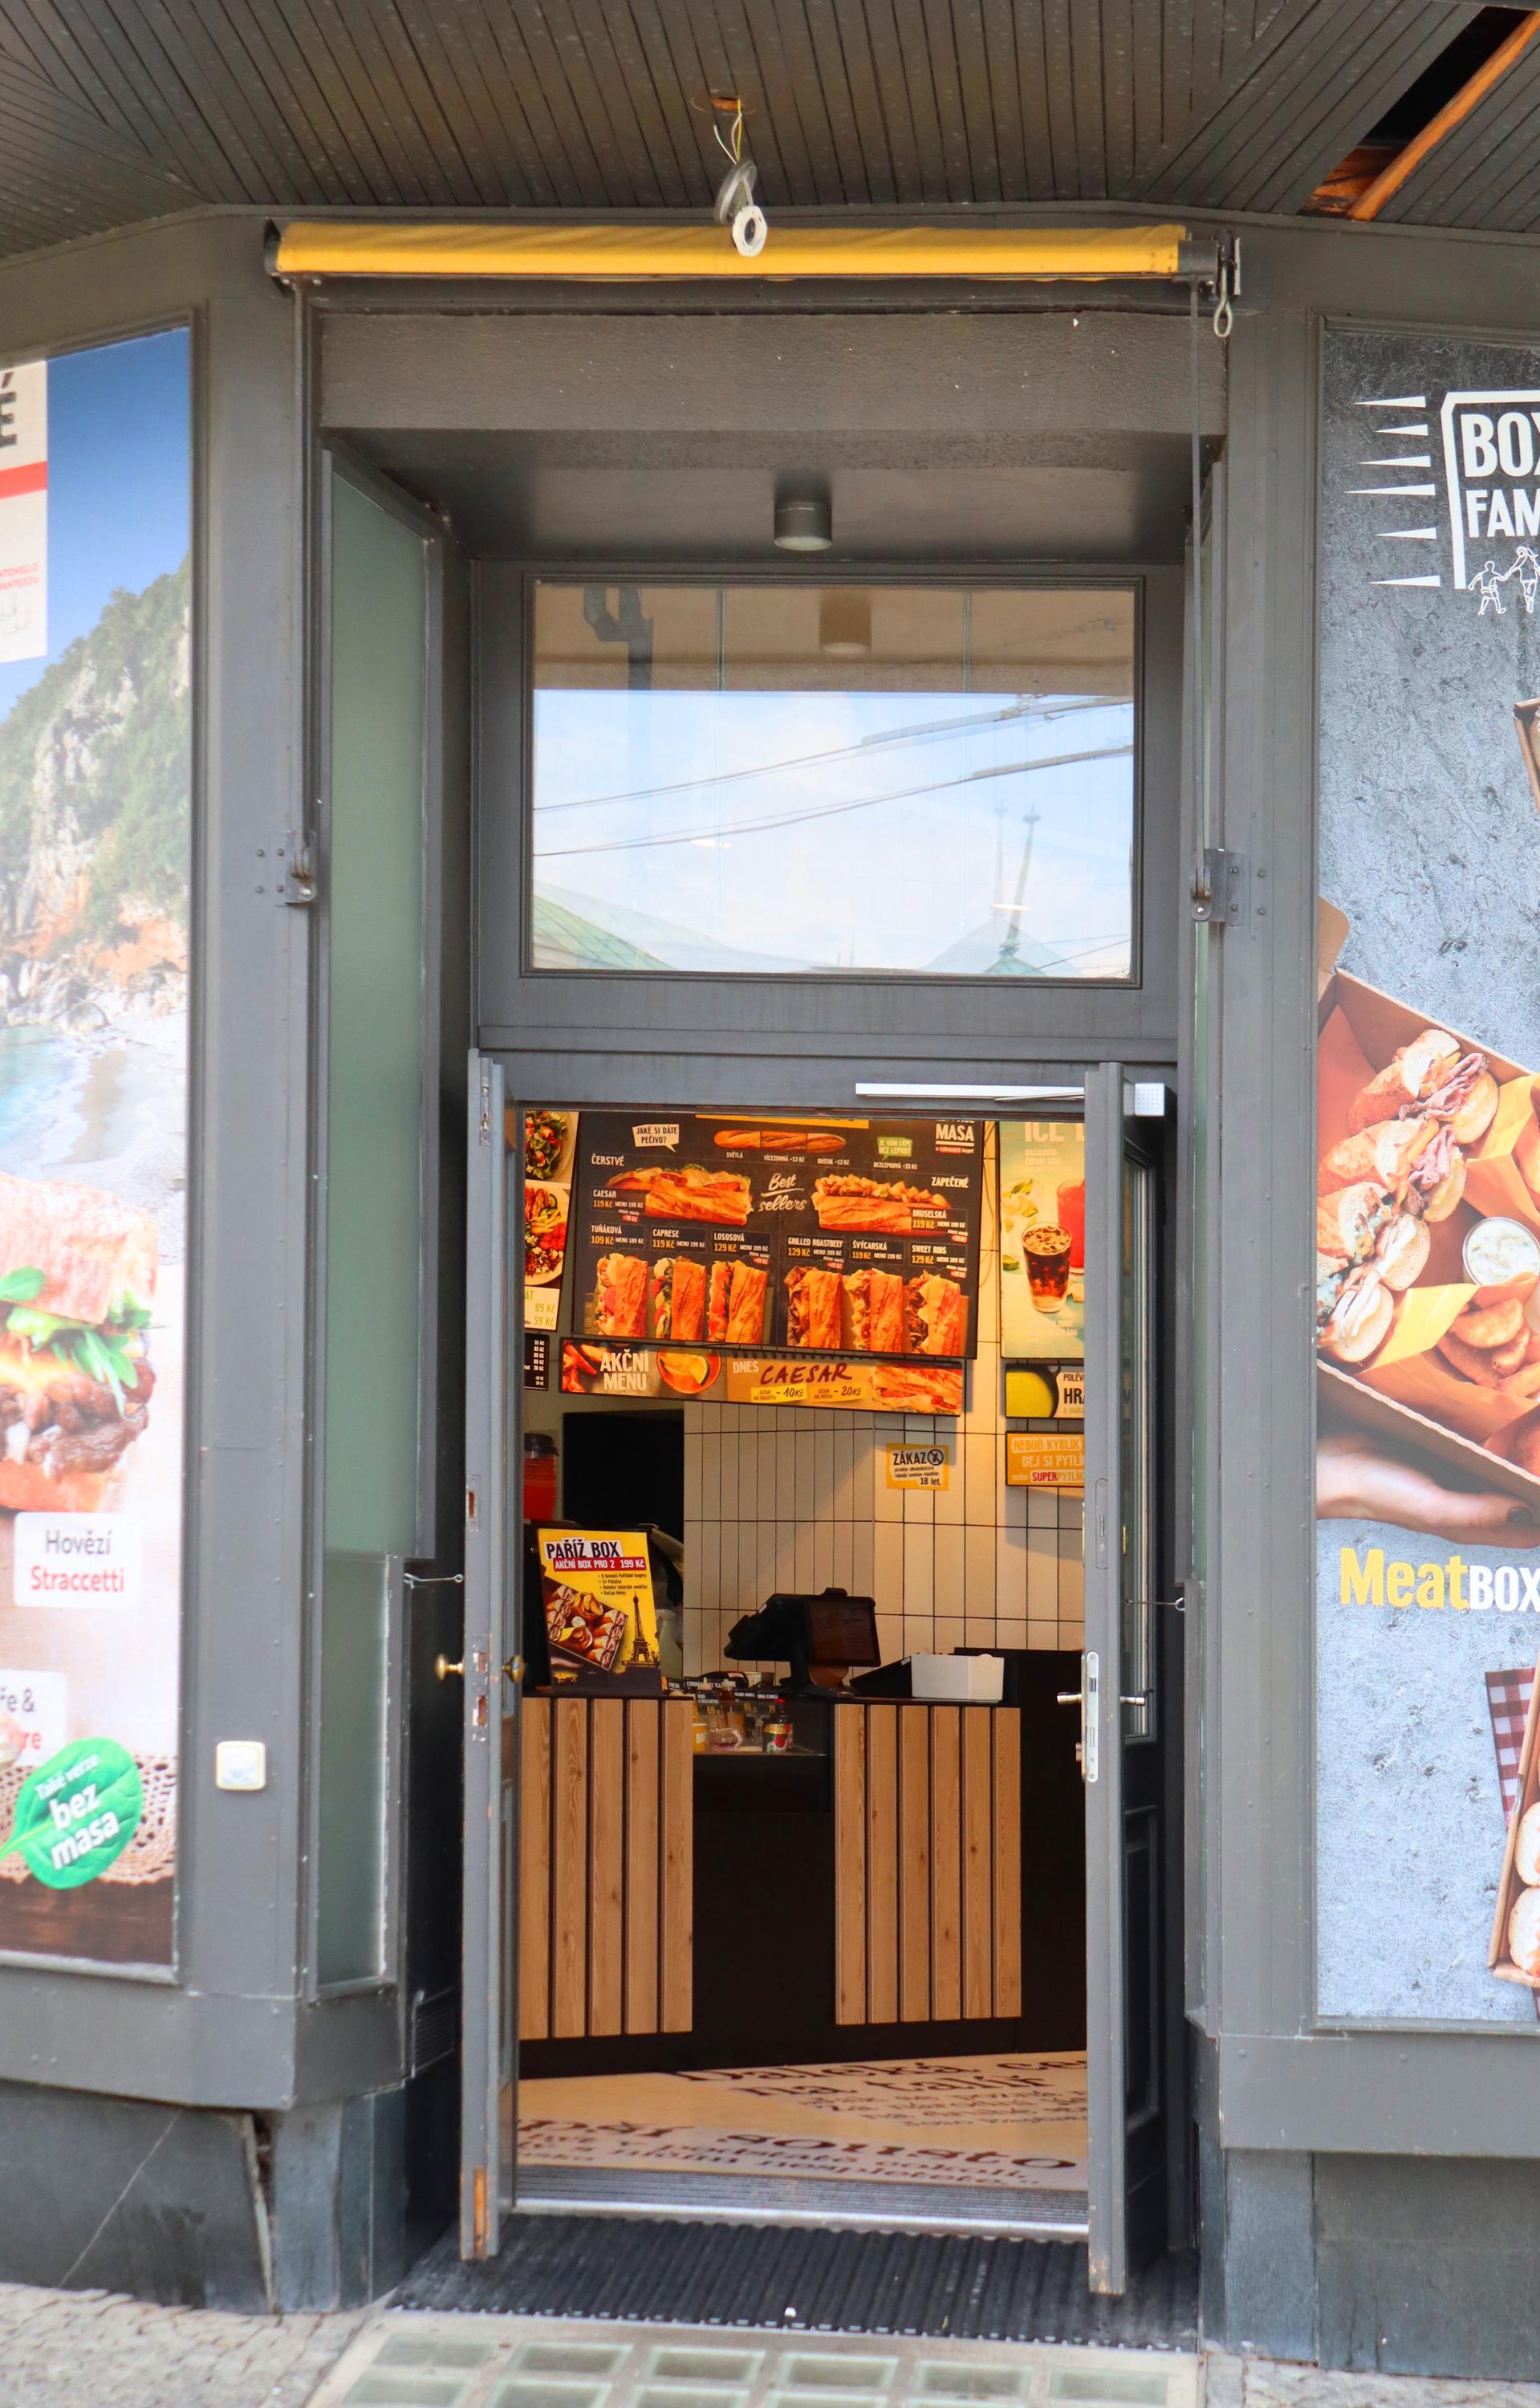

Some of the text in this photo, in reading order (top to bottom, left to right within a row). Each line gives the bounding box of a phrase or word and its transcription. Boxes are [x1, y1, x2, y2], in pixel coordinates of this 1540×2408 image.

[636, 1125, 678, 1134] JAKÉ SI DÁTE
[935, 1123, 974, 1141] MASA
[641, 1136, 667, 1144] PEČIVO?
[591, 1153, 624, 1166] ČERSTVÉ
[768, 1173, 797, 1190] Best
[931, 1176, 969, 1188] ZAPEČENÉ
[593, 1189, 616, 1198] CAESAR
[593, 1199, 605, 1208] 119
[605, 1200, 613, 1208] Kč
[758, 1194, 807, 1212] sellers
[912, 1209, 947, 1219] BRUSELSKÁ
[591, 1224, 622, 1235] TUŇÁKOVÁ
[912, 1219, 925, 1228] 119
[926, 1220, 935, 1229] Kč
[652, 1229, 680, 1239] CAPRESE
[713, 1232, 745, 1242] LOSOSOVÁ
[591, 1236, 604, 1244] 109
[605, 1236, 614, 1245] Kč
[652, 1239, 665, 1248] 119
[665, 1240, 675, 1249] Kč
[788, 1237, 843, 1248] GRILLED ROASTBEEF
[852, 1239, 888, 1251] ŠVÝCARSKÁ
[714, 1243, 726, 1251] 129
[727, 1243, 737, 1252] Kč
[788, 1247, 801, 1256] 129
[801, 1248, 811, 1257] Kč
[912, 1245, 947, 1255] SWEET RIBS
[863, 1251, 872, 1259] Kč
[912, 1255, 924, 1263] 129
[925, 1255, 934, 1264] Kč
[535, 1303, 555, 1314] 89 Kč
[534, 1316, 543, 1325] 59
[545, 1317, 555, 1327] Kč
[600, 1348, 649, 1372] AKČNÍ
[733, 1361, 759, 1374] DNES
[760, 1362, 852, 1385] CAESAR
[1063, 1372, 1084, 1381] POLÉV
[603, 1373, 647, 1391] MENU
[1064, 1388, 1084, 1404] HR
[1014, 1438, 1079, 1451] NEBUĎ KYBLÍK
[893, 1450, 927, 1466] ZÁKAZ
[1022, 1455, 1040, 1467] DEJ
[1043, 1455, 1053, 1466] SI
[920, 1477, 928, 1485] 18
[46, 1529, 113, 1555] Hovězí
[546, 1539, 620, 1559] PAŘÍŽ BOX
[555, 1559, 645, 1569] AKČNÍ BOX PRO 2 199 Kč
[30, 1565, 124, 1592] Straccetti
[22, 1687, 35, 1713] &
[35, 1754, 100, 1800] Také verze
[50, 1783, 102, 1831] bez
[51, 1810, 120, 1870] masa
